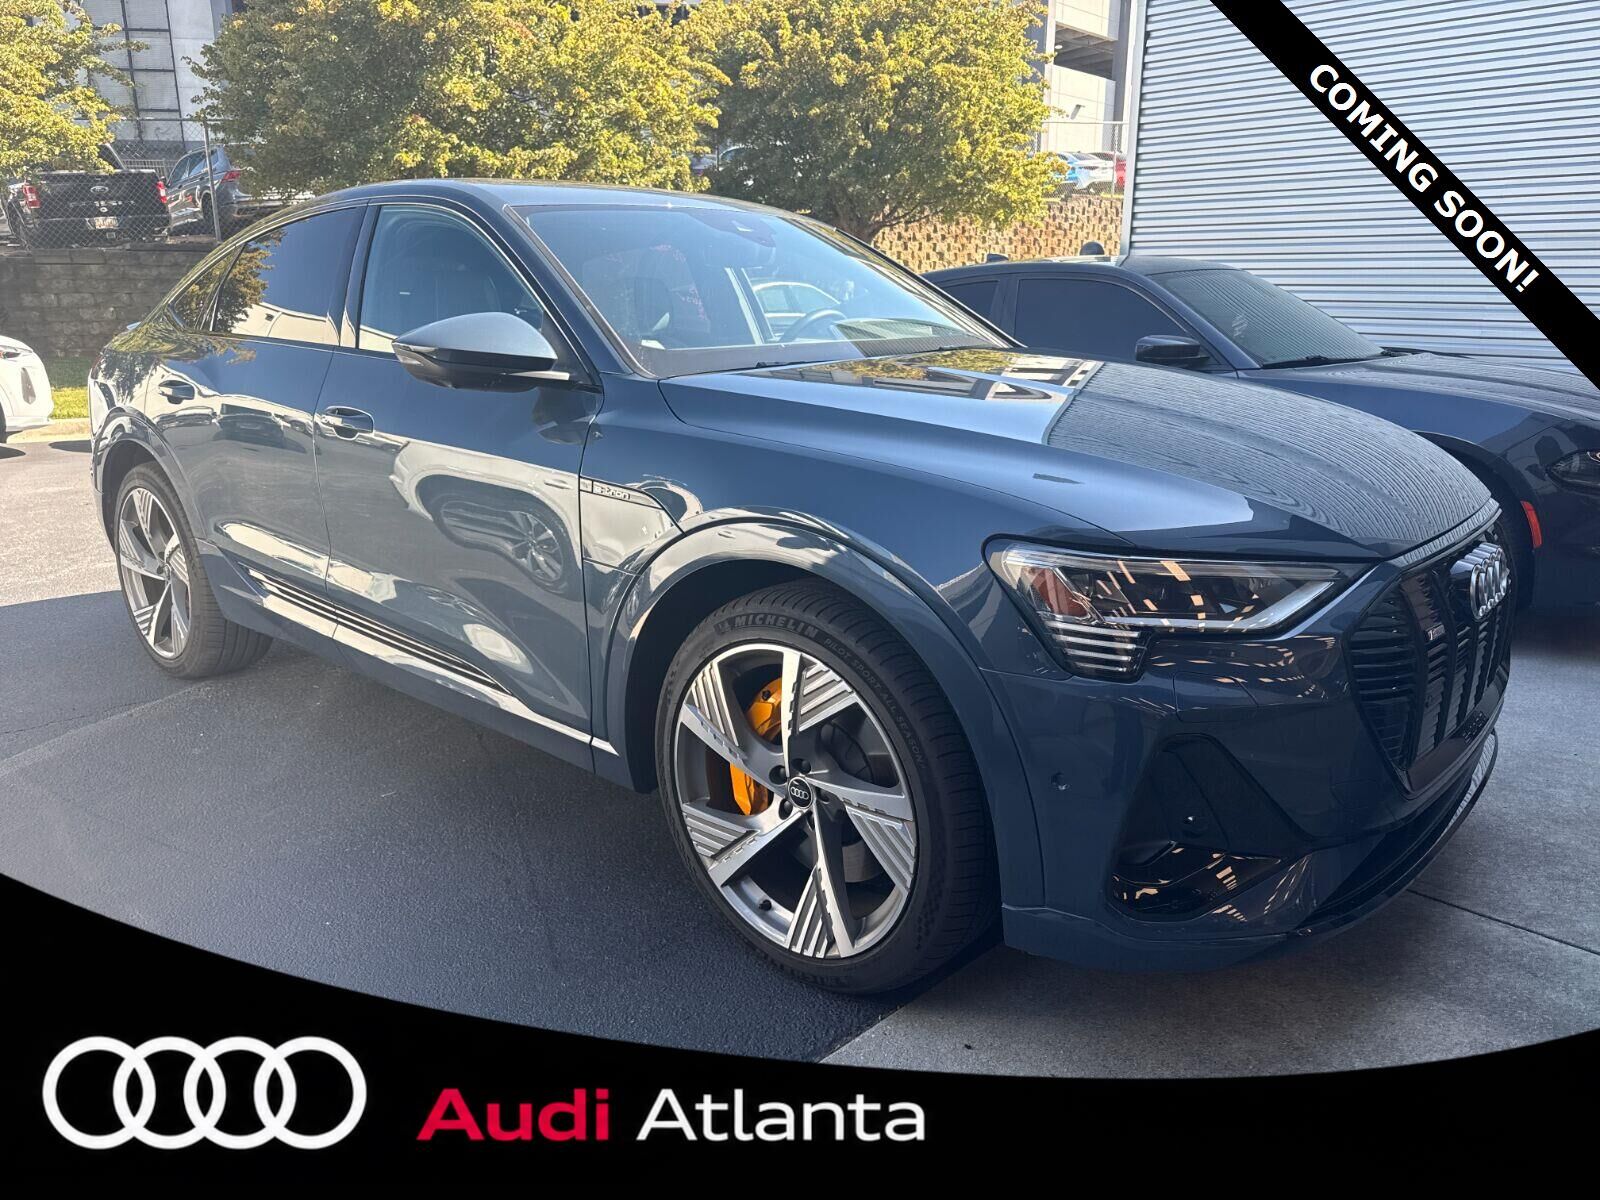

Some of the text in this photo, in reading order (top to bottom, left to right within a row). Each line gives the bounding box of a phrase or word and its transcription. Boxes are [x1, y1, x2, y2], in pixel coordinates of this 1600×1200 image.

[735, 614, 818, 638] MICHELIN
[824, 638, 850, 660] PILOT
[851, 660, 881, 690] SPORT
